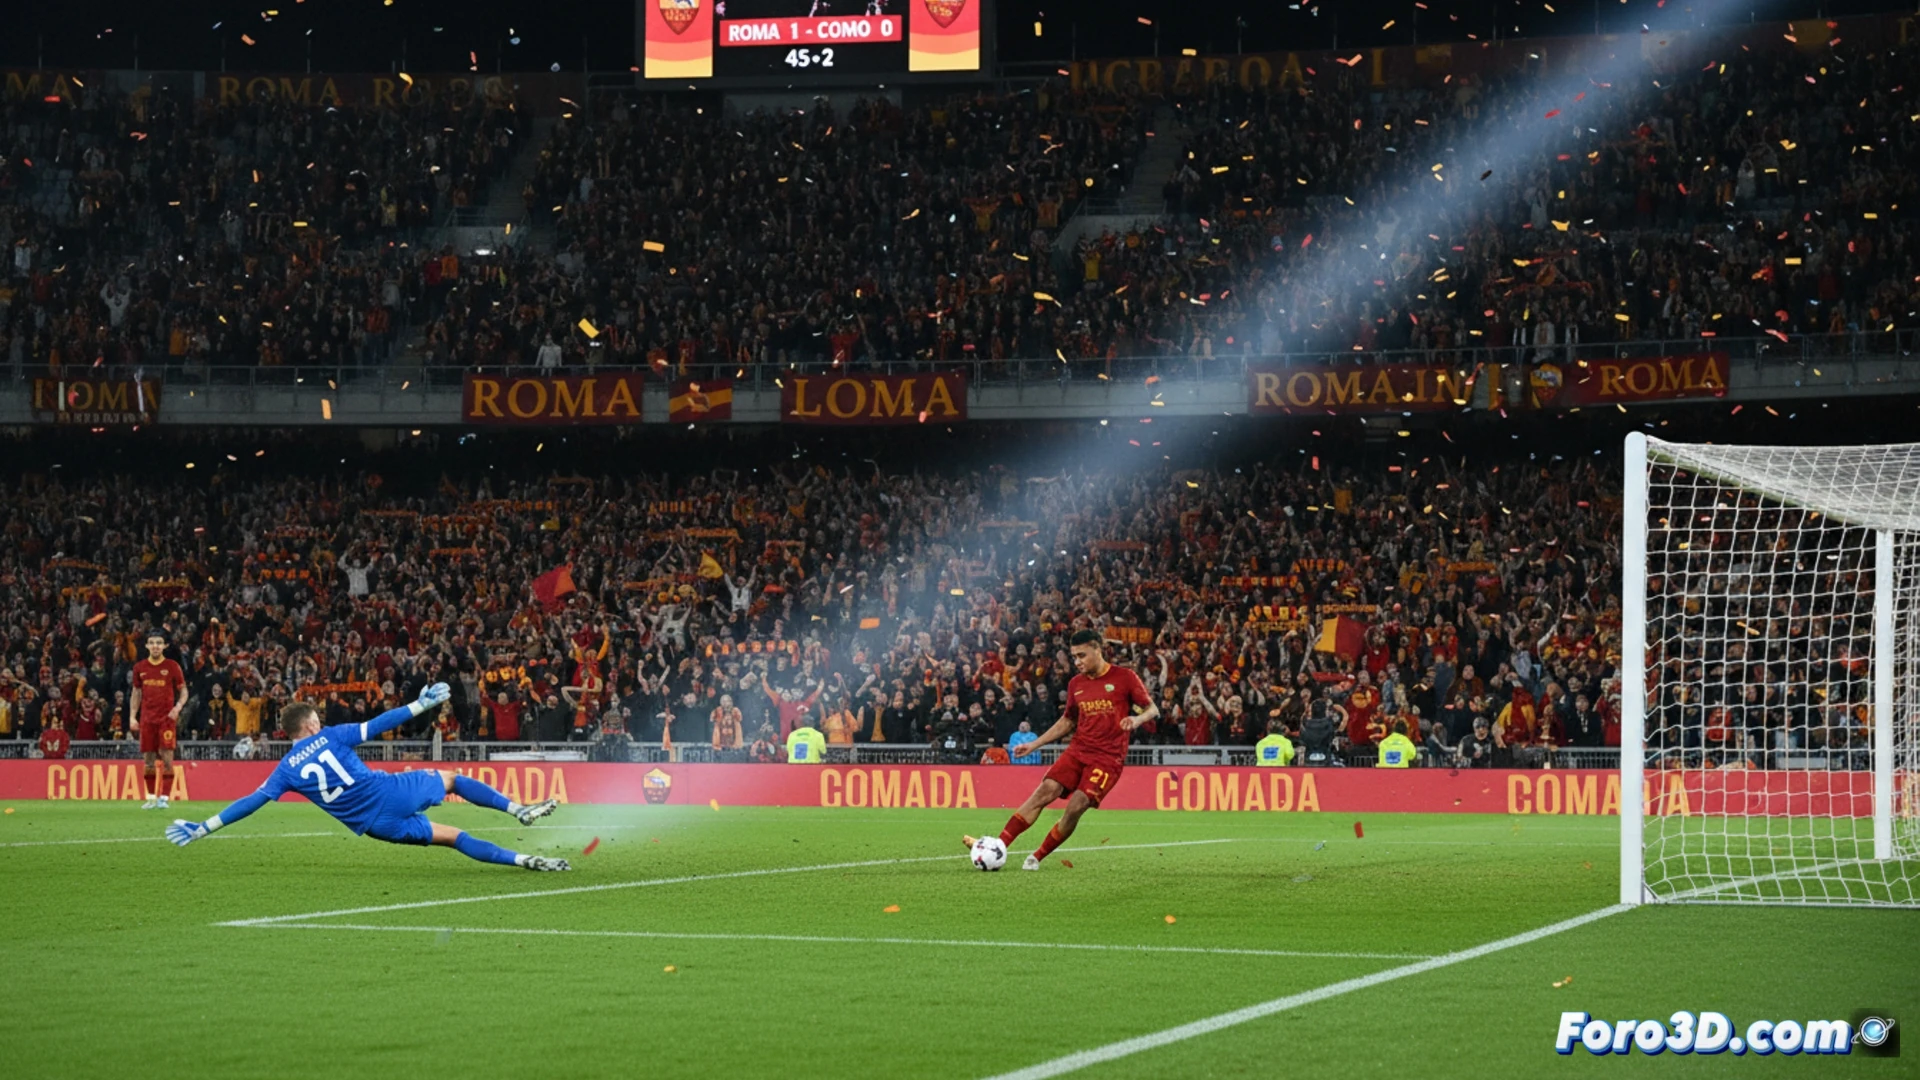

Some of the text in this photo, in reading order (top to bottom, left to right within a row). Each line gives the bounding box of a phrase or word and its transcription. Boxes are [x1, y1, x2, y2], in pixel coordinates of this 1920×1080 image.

[728, 21, 781, 42] ROMA
[790, 22, 799, 40] 1
[817, 19, 872, 40] COMO
[880, 18, 895, 38] 0
[218, 77, 341, 107] ROMA
[1599, 357, 1726, 396] ROMA
[470, 379, 640, 417] ROMA
[790, 377, 958, 418] LOMA
[300, 748, 356, 804] 21
[820, 768, 977, 808] COMADA
[1089, 768, 1109, 789] 21
[1156, 771, 1320, 811] COMADA
